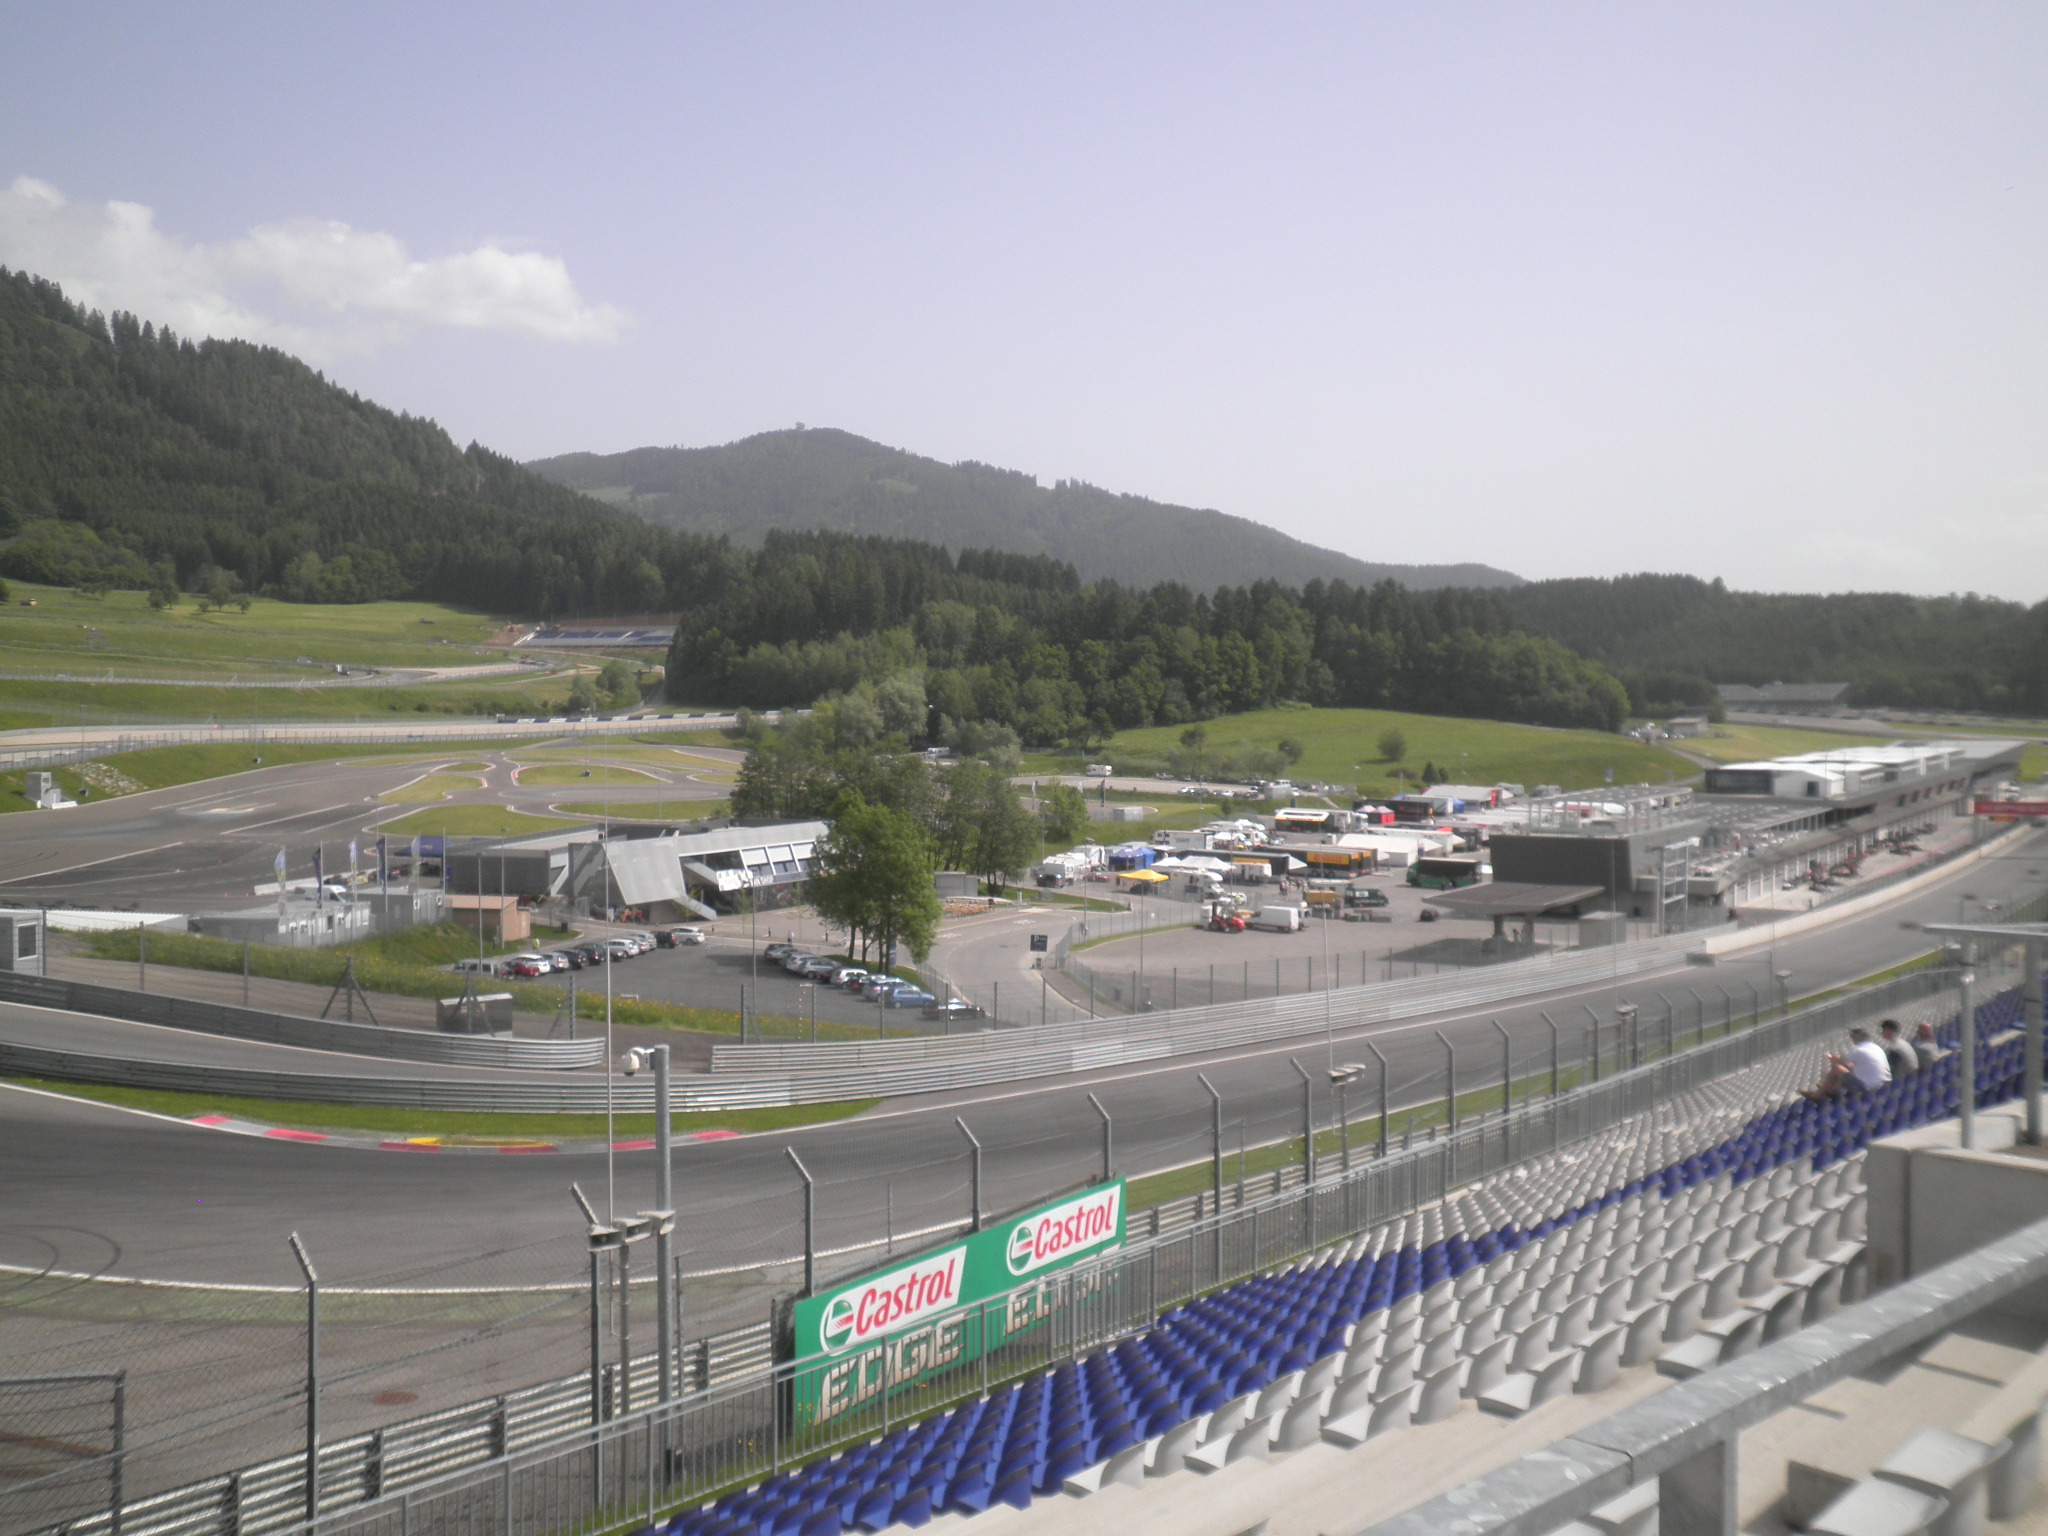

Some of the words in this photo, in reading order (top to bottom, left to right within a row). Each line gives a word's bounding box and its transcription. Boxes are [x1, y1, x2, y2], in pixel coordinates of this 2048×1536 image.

[1035, 1194, 1114, 1260] Castrol
[856, 1258, 956, 1337] Castrol
[815, 1311, 968, 1425] EDGE
